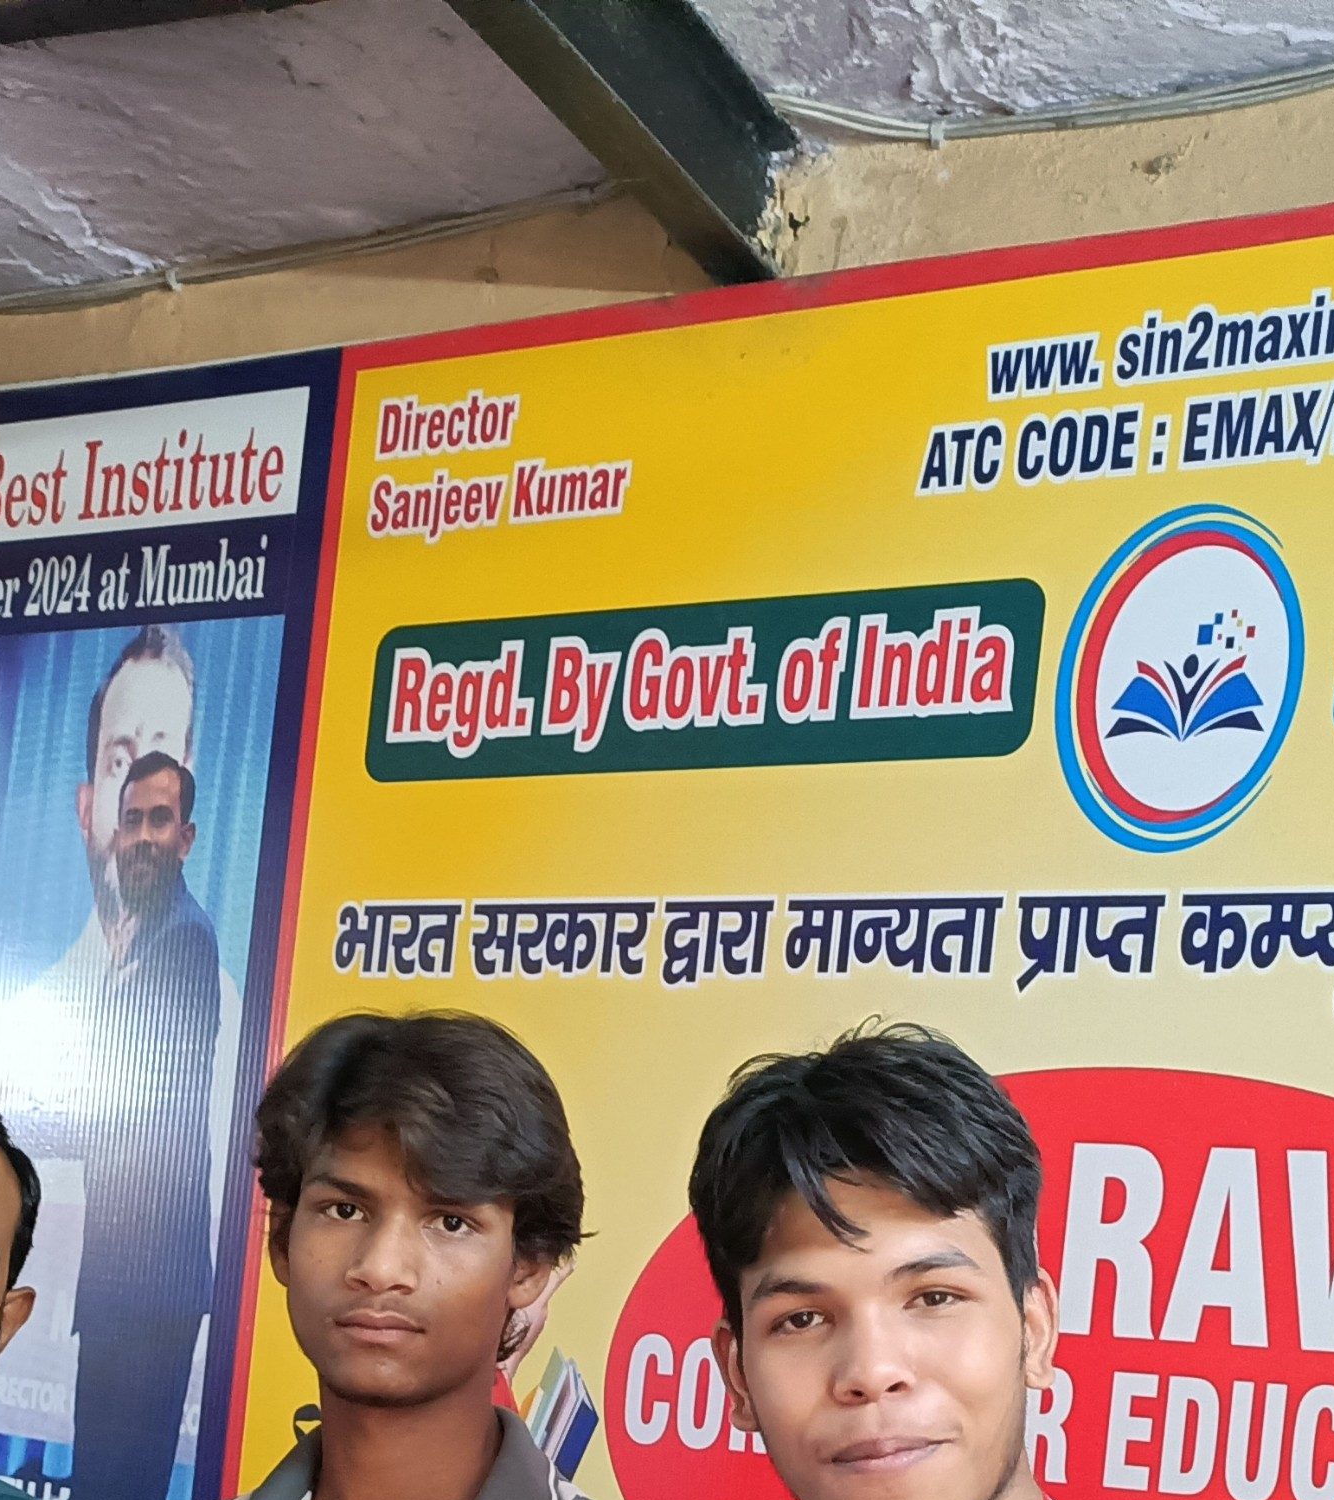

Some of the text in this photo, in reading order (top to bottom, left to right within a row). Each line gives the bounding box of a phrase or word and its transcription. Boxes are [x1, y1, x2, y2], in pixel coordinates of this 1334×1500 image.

[993, 339, 1098, 394] www.
[379, 396, 516, 454] Director
[922, 426, 1000, 489] ATC
[1019, 411, 1137, 481] CODE
[78, 427, 285, 520] Institute
[370, 464, 628, 539] Sanjeev Kumar
[24, 554, 92, 617] 2024
[98, 565, 130, 611] at
[138, 536, 267, 604] Mumbai
[392, 617, 1005, 749] Regd. By Govt. of India
[333, 900, 462, 975] भारत
[472, 899, 656, 972] सरकार
[662, 898, 773, 984] द्वारा
[784, 895, 1003, 975] मान्यता
[1015, 894, 1165, 992] प्राप्त
